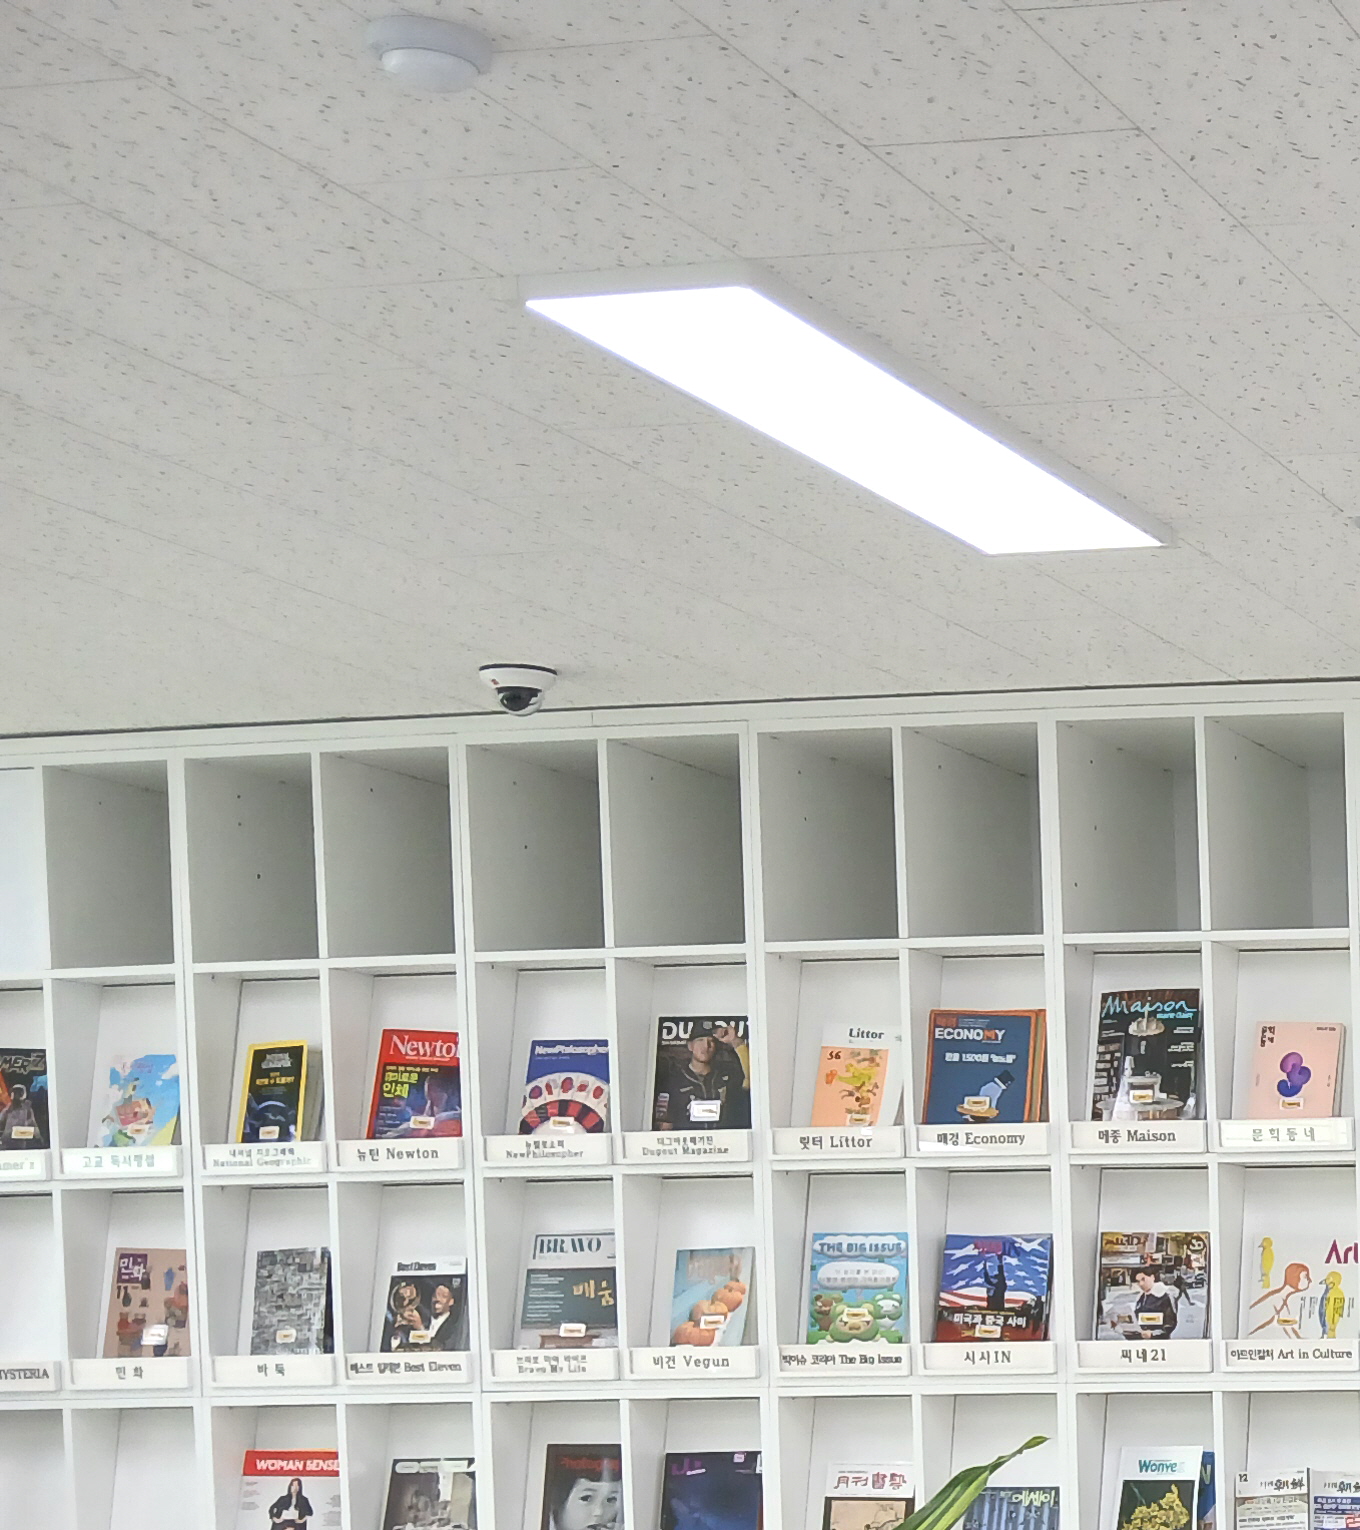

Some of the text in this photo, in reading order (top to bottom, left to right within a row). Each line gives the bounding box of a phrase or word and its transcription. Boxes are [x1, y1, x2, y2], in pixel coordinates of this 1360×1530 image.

[848, 1028, 885, 1040] Littor
[934, 1028, 1006, 1042] ECONOMY
[388, 1034, 460, 1058] Newto
[799, 1135, 873, 1150] 릿터 Littor
[964, 1132, 1026, 1146] Economy
[1098, 1129, 1177, 1144] 메종 Maison
[386, 1147, 440, 1160] Newton
[839, 1354, 856, 1365] The
[877, 1354, 903, 1364] Issue
[1277, 1348, 1295, 1360] Art
[1298, 1348, 1310, 1360] in
[1312, 1347, 1353, 1360] Culture
[404, 1361, 425, 1373] Best
[1138, 1459, 1178, 1473] Wonye
